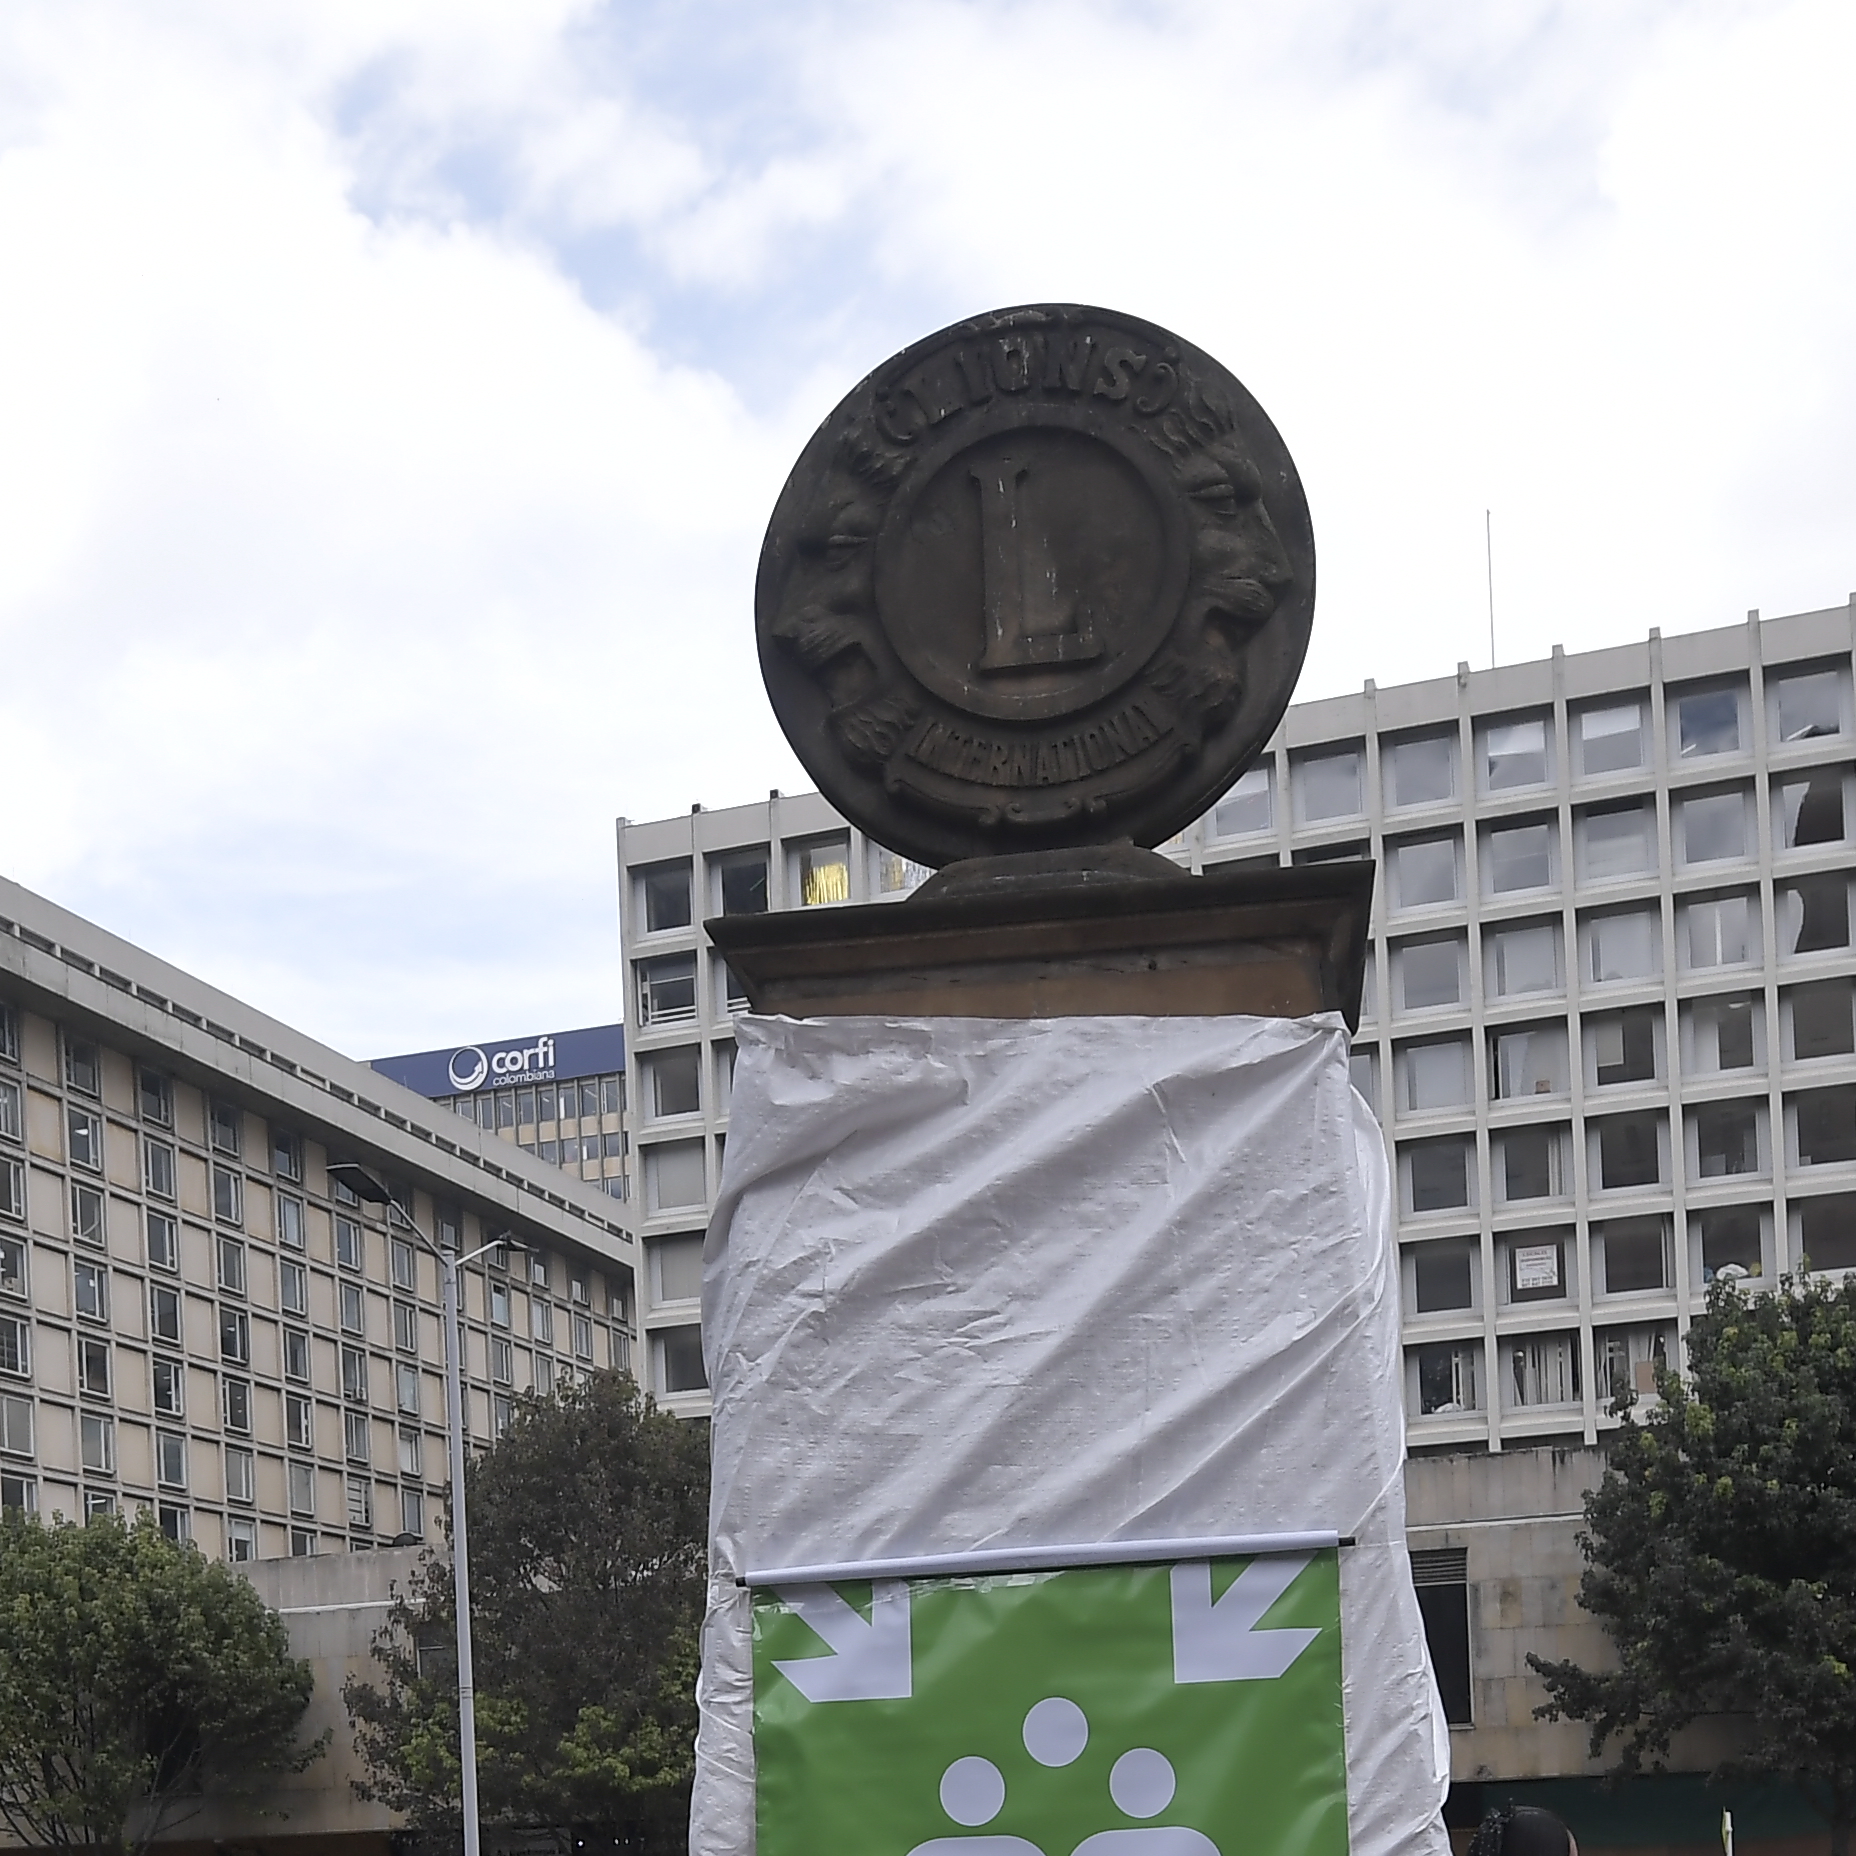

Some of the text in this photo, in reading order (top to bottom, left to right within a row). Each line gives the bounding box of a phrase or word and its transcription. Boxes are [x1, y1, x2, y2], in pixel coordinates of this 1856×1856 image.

[919, 335, 1145, 419] LIONS
[969, 464, 1105, 673] L
[914, 704, 1172, 787] INTERNATIONAL
[491, 1036, 555, 1074] corfi
[493, 1069, 555, 1086] colombiana
